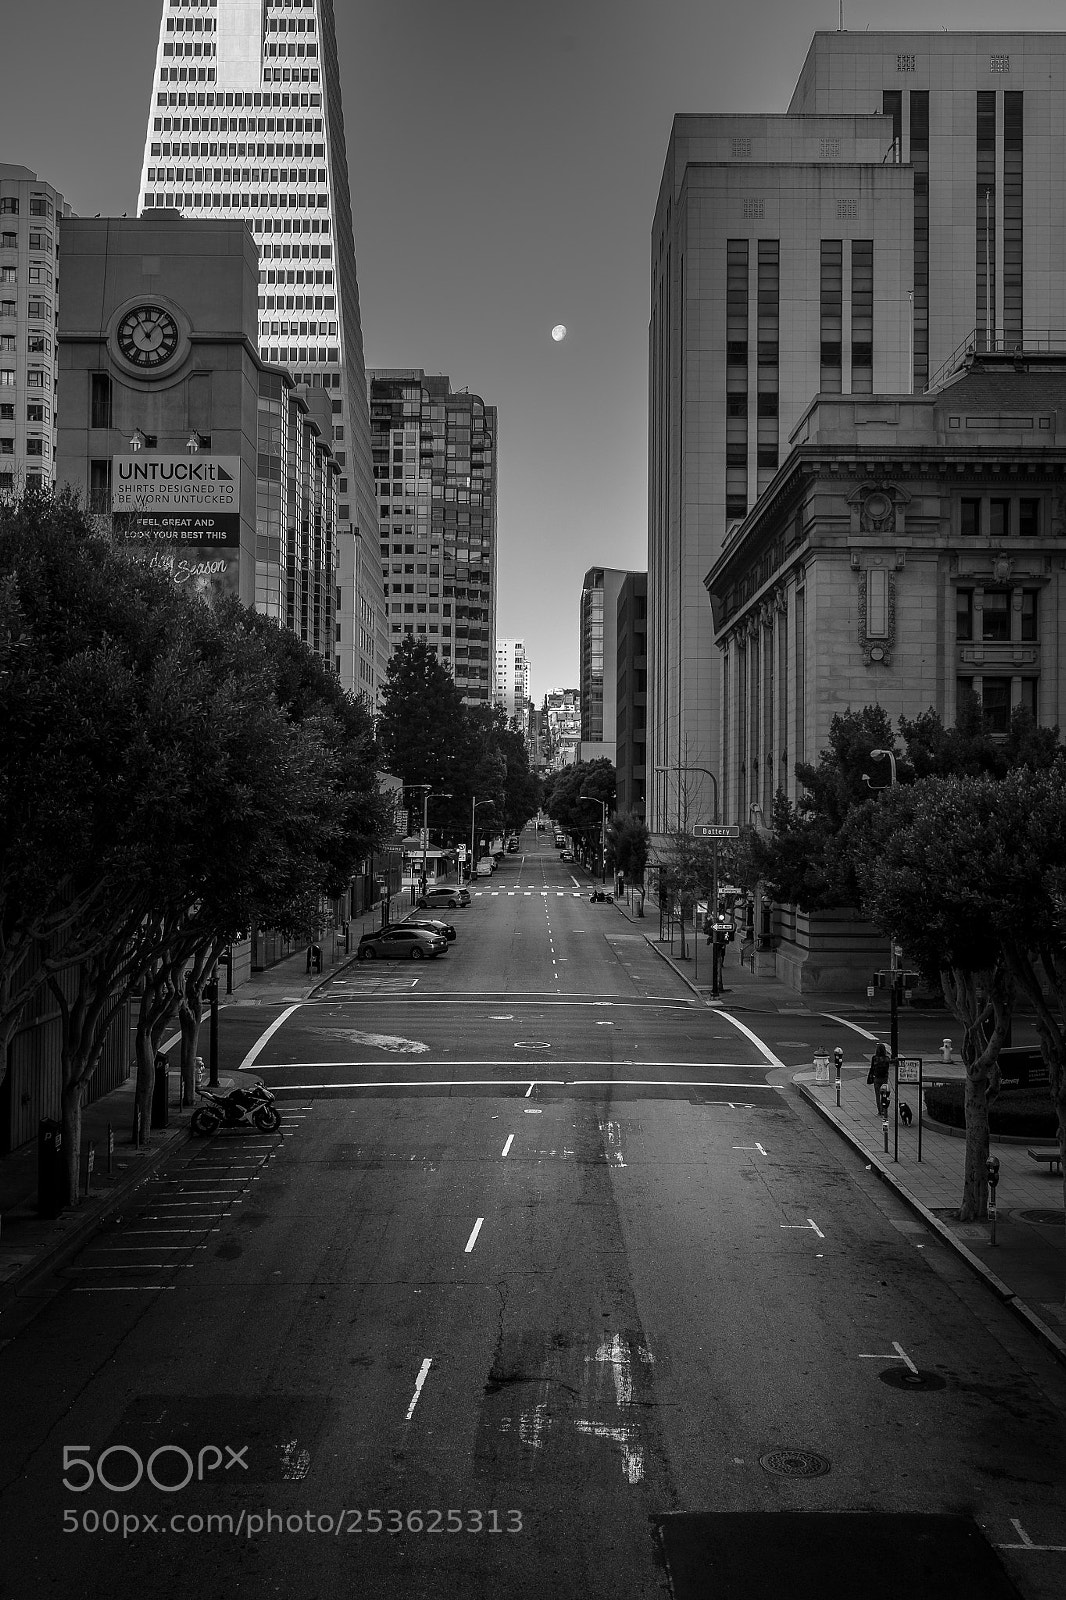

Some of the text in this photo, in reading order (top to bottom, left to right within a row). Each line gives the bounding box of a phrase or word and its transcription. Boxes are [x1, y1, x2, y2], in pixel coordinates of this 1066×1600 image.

[119, 463, 215, 480] UNTUCKit
[118, 484, 234, 493] SHIRTS DESIGNED TO
[118, 494, 234, 504] BE WORN UNTUCKED
[136, 518, 215, 527] FEEL GREAT AND
[125, 531, 227, 540] LOOK YOUR BEST THIS
[702, 827, 730, 836] Battery
